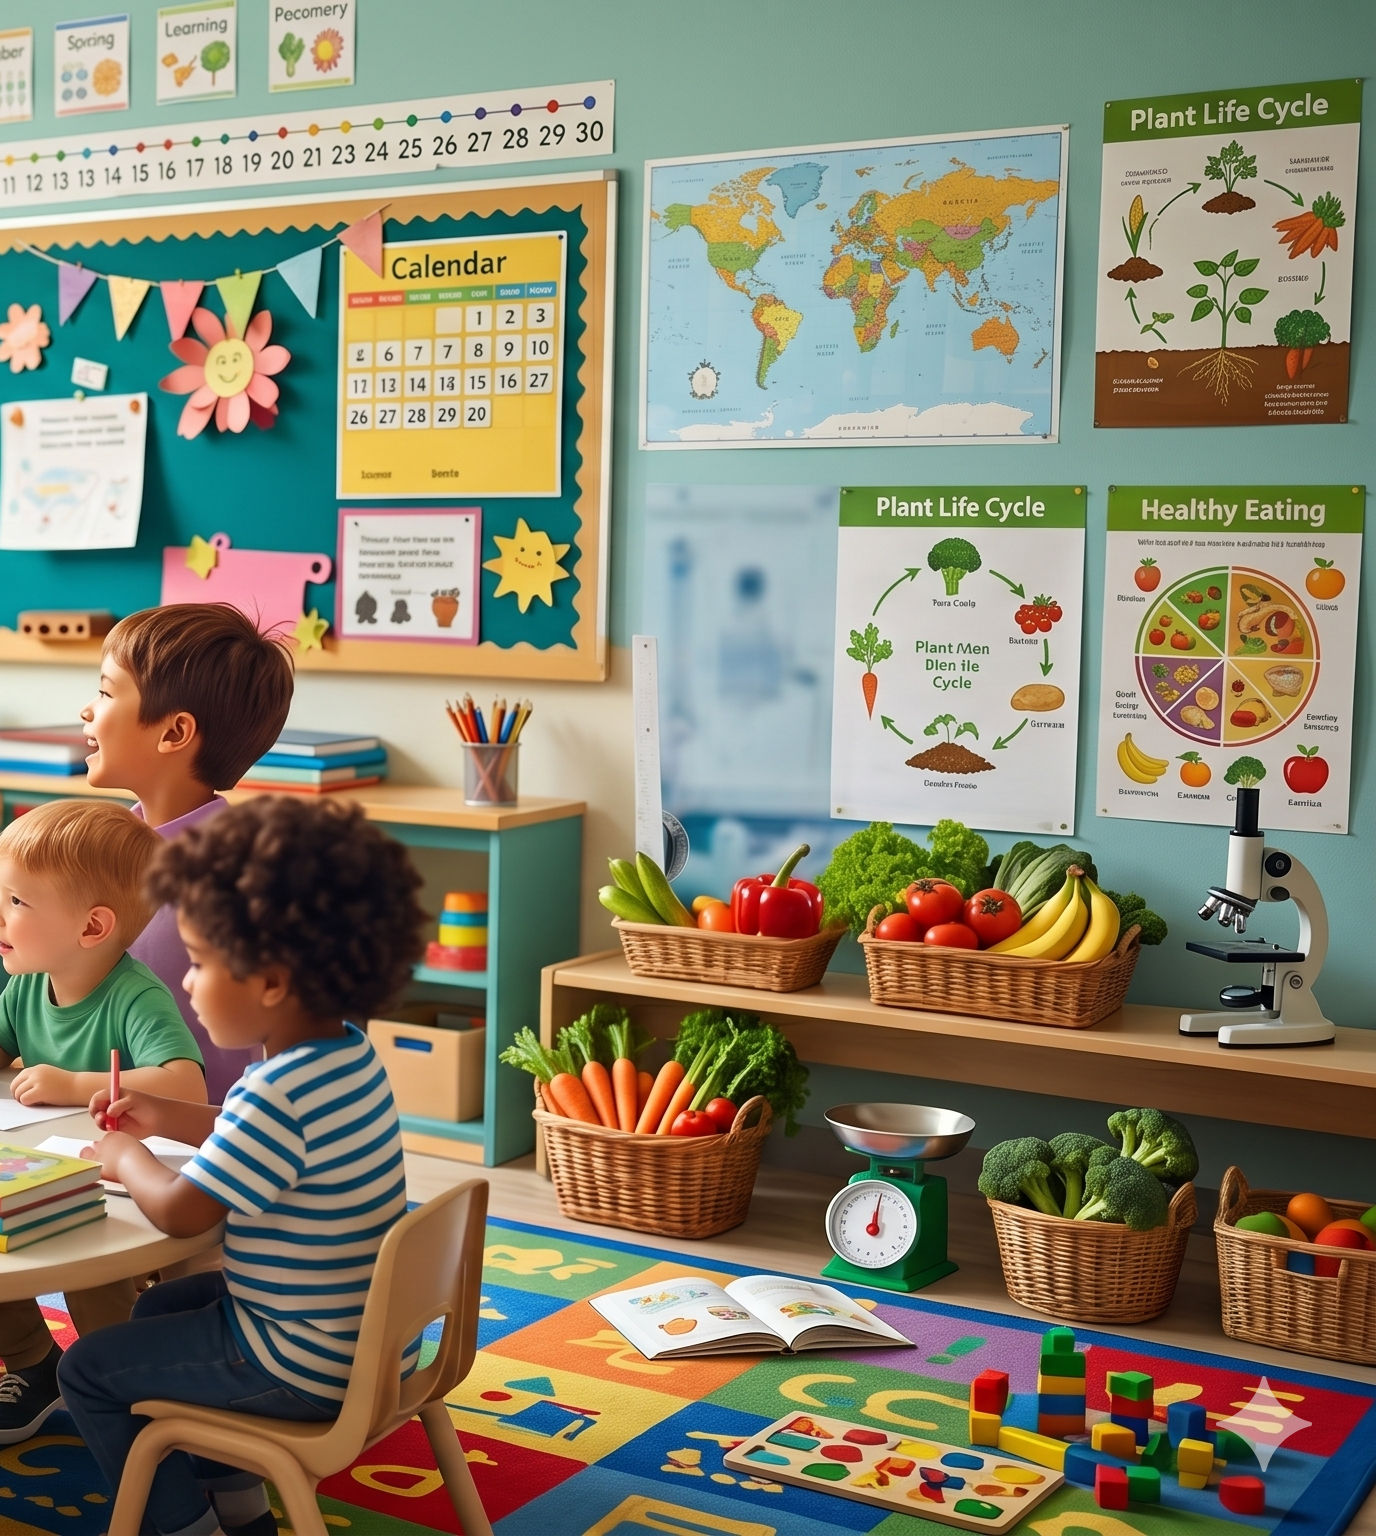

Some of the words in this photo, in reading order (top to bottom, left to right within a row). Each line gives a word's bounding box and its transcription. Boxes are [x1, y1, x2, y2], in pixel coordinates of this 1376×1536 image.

[165, 18, 227, 37] Learning
[1131, 107, 1196, 131] Plant
[1204, 100, 1249, 124] Life
[1257, 93, 1328, 124] Cycle
[3, 176, 15, 193] 11
[27, 174, 42, 191] 12
[53, 172, 68, 190] 13
[79, 169, 94, 187] 13
[105, 167, 121, 184] 14
[133, 164, 148, 182] 15
[159, 161, 176, 179] 16
[187, 158, 204, 176] 17
[215, 156, 232, 174] 18
[243, 153, 261, 172] 19
[271, 150, 293, 170] 20
[304, 148, 320, 167] 21
[332, 144, 355, 164] 23
[365, 141, 388, 162] 24
[399, 138, 422, 159] 25
[433, 135, 457, 155] 26
[468, 132, 492, 152] 27
[503, 128, 528, 149] 28
[540, 124, 565, 146] 29
[576, 121, 603, 142] 30
[392, 251, 506, 279] Calendar
[477, 311, 482, 326] 1
[506, 310, 514, 324] 2
[536, 308, 545, 322] 3
[385, 347, 393, 361] 6
[415, 346, 422, 360] 7
[444, 345, 452, 358] 7
[474, 343, 483, 357] 8
[505, 342, 513, 356] 9
[533, 340, 548, 355] 10
[382, 378, 395, 392] 13
[411, 378, 426, 392] 14
[470, 376, 485, 389] 15
[501, 374, 516, 388] 16
[530, 373, 548, 387] 27
[351, 411, 367, 424] 26
[380, 410, 396, 423] 27
[408, 409, 425, 423] 28
[438, 408, 456, 422] 29
[877, 496, 933, 517] Plant
[940, 497, 979, 517] Life
[985, 497, 1045, 522] Cycle
[1142, 498, 1238, 526] Healthy
[1246, 499, 1325, 526] Eating
[916, 641, 953, 653] Plant
[957, 643, 989, 654] Men
[933, 676, 971, 690] Cycle
